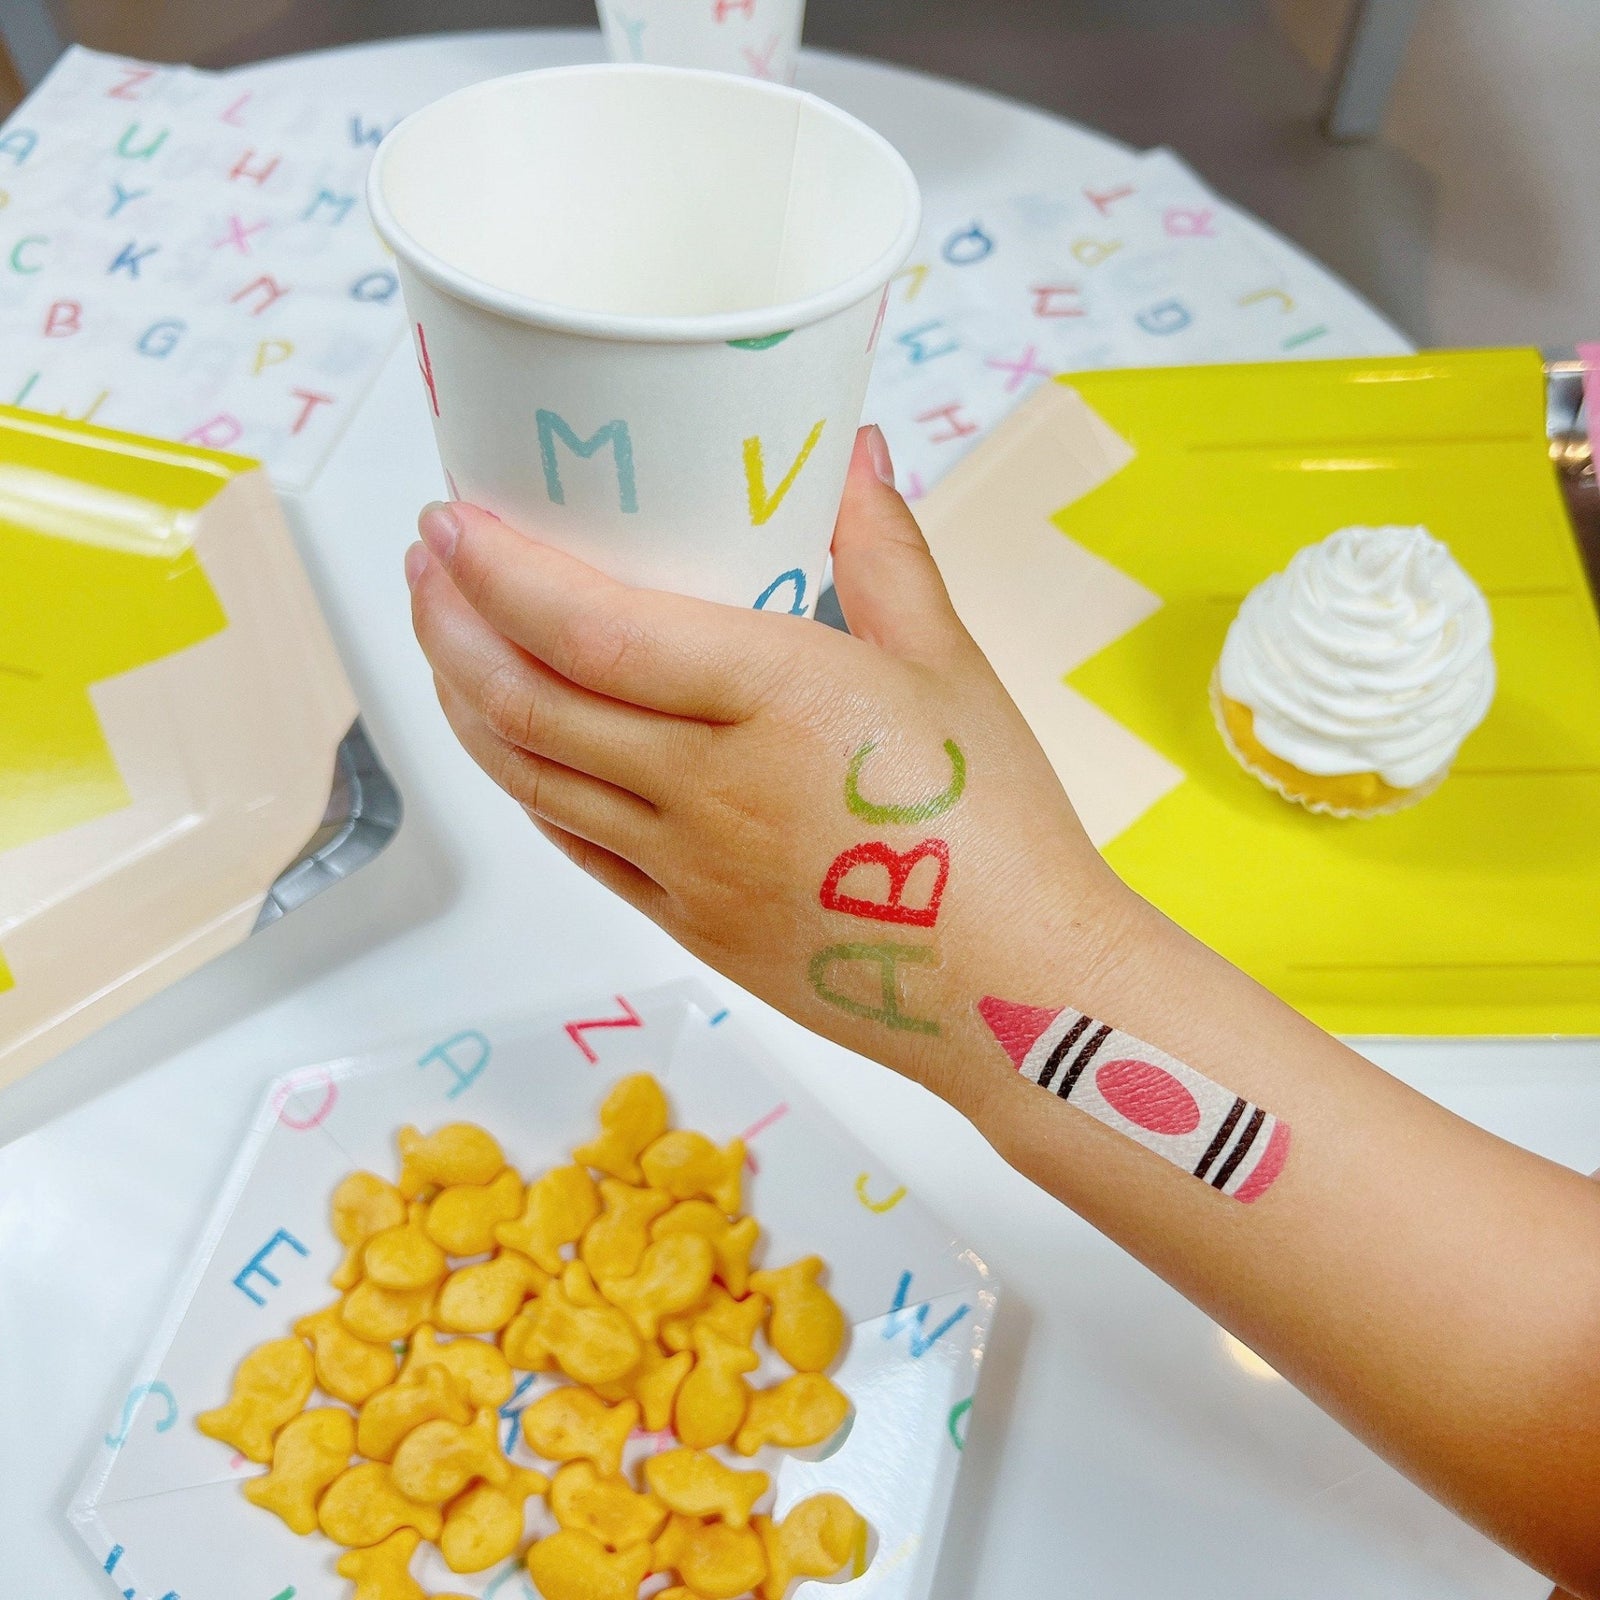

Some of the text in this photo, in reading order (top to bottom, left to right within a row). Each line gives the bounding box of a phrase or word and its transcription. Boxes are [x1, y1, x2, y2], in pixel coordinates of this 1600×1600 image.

[117, 123, 169, 160] U
[229, 149, 281, 185] H
[106, 183, 150, 219] Y
[213, 215, 270, 254] X
[9, 235, 50, 274] C
[107, 240, 160, 279] K
[43, 300, 82, 337] B
[252, 340, 294, 378] P
[985, 345, 1052, 394] X
[291, 386, 334, 435] T
[535, 408, 638, 514] M
[742, 418, 827, 527] V
[807, 738, 966, 1037] ABC
[232, 1227, 308, 1306] E
